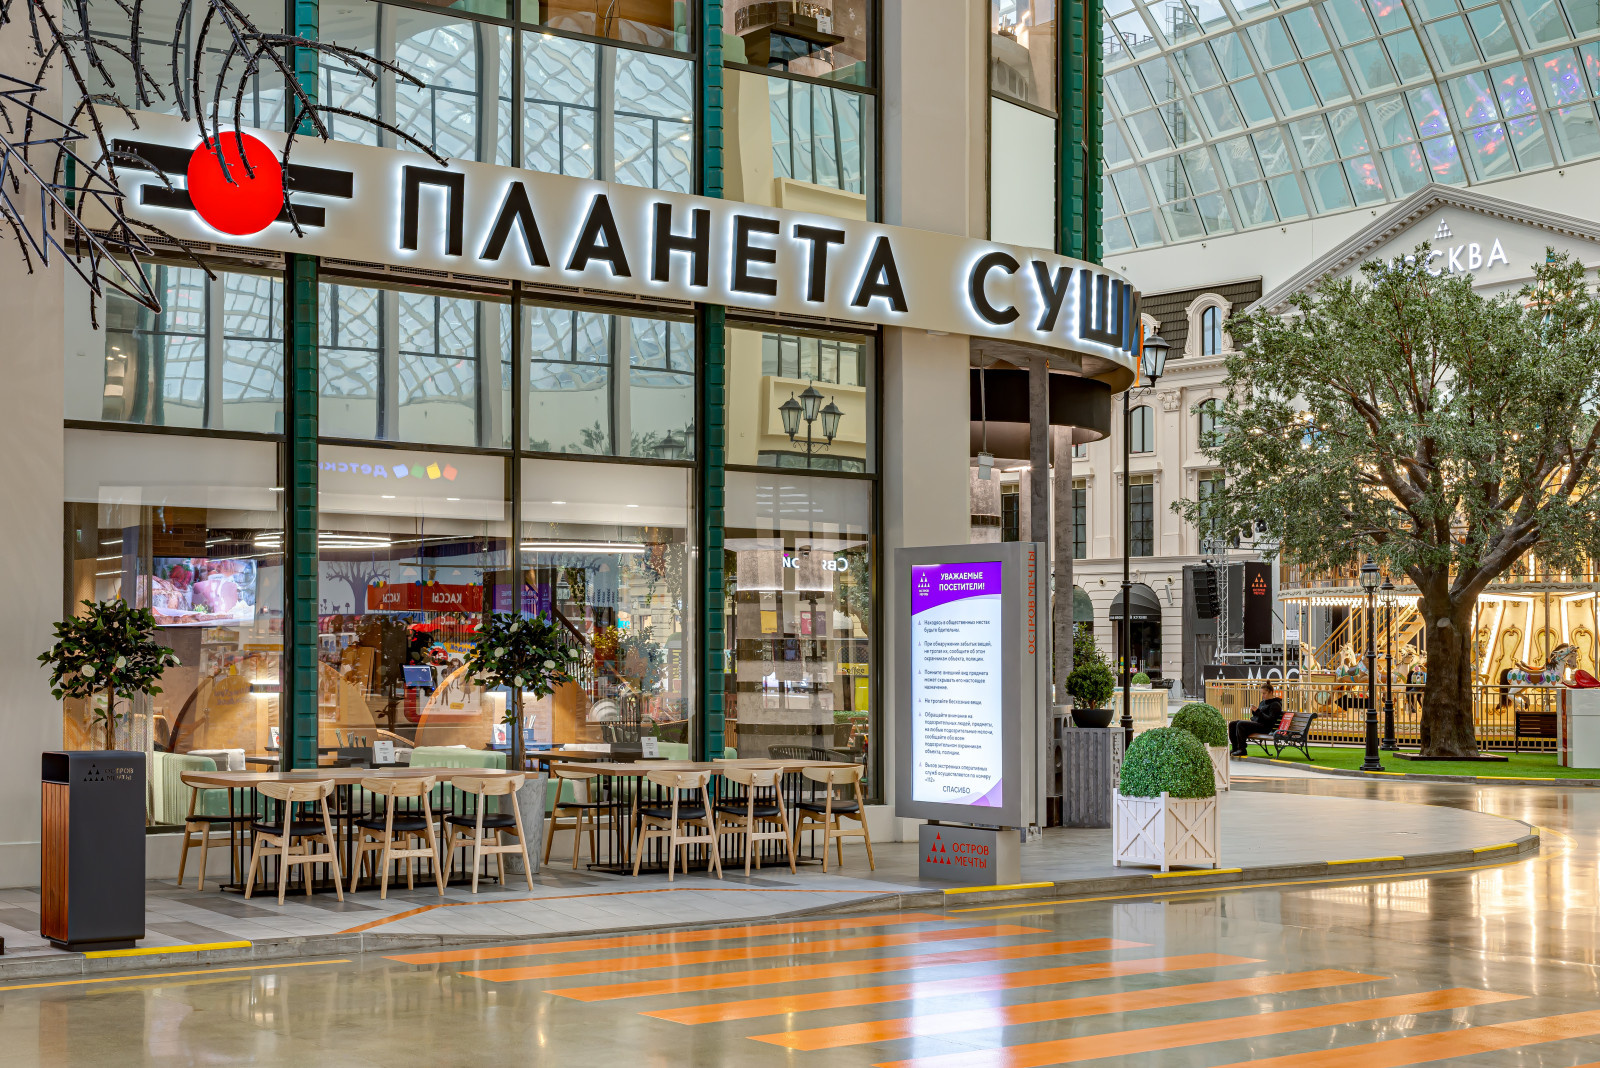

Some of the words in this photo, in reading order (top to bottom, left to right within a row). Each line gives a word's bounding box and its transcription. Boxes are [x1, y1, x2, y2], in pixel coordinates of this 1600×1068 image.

[400, 165, 908, 312] ПЛАНЕТА
[968, 251, 1141, 357] СУШИ
[1375, 237, 1509, 287] СКВА
[940, 572, 983, 580] УВАЖАЕМЫЕ
[938, 582, 985, 591] ПОСЕТИТЕЛИ!
[942, 785, 971, 794] СПАСИБО
[952, 842, 990, 855] ОСТРОВ
[955, 856, 987, 868] МЕЧТЫ
